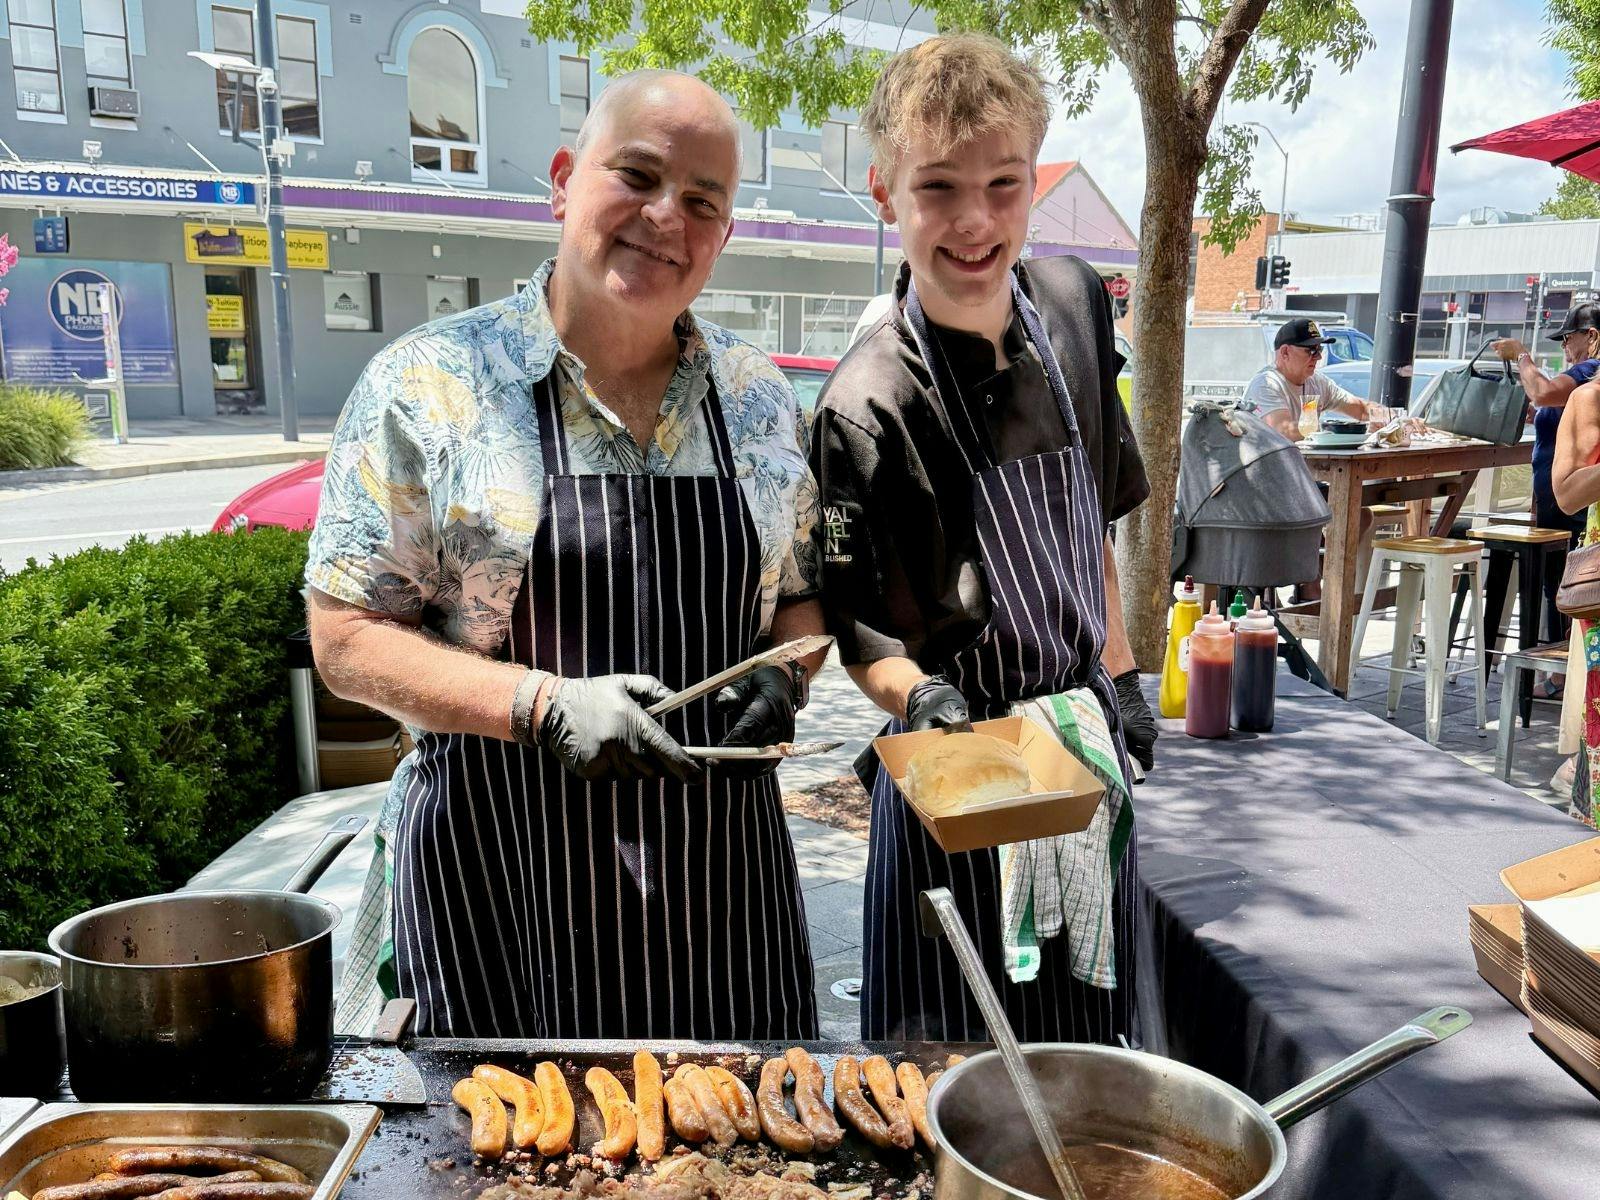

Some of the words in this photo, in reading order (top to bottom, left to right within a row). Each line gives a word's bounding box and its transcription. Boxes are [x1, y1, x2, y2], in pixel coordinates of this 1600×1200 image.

[0, 173, 42, 191] NES
[46, 175, 60, 192] &
[66, 176, 198, 199] ACCESSORIES
[287, 239, 323, 252] anbeyan
[334, 302, 359, 311] Aussie
[65, 315, 104, 325] PHONE
[823, 506, 852, 523] YAL
[823, 522, 850, 538] TEL
[825, 554, 853, 562] BLISHED
